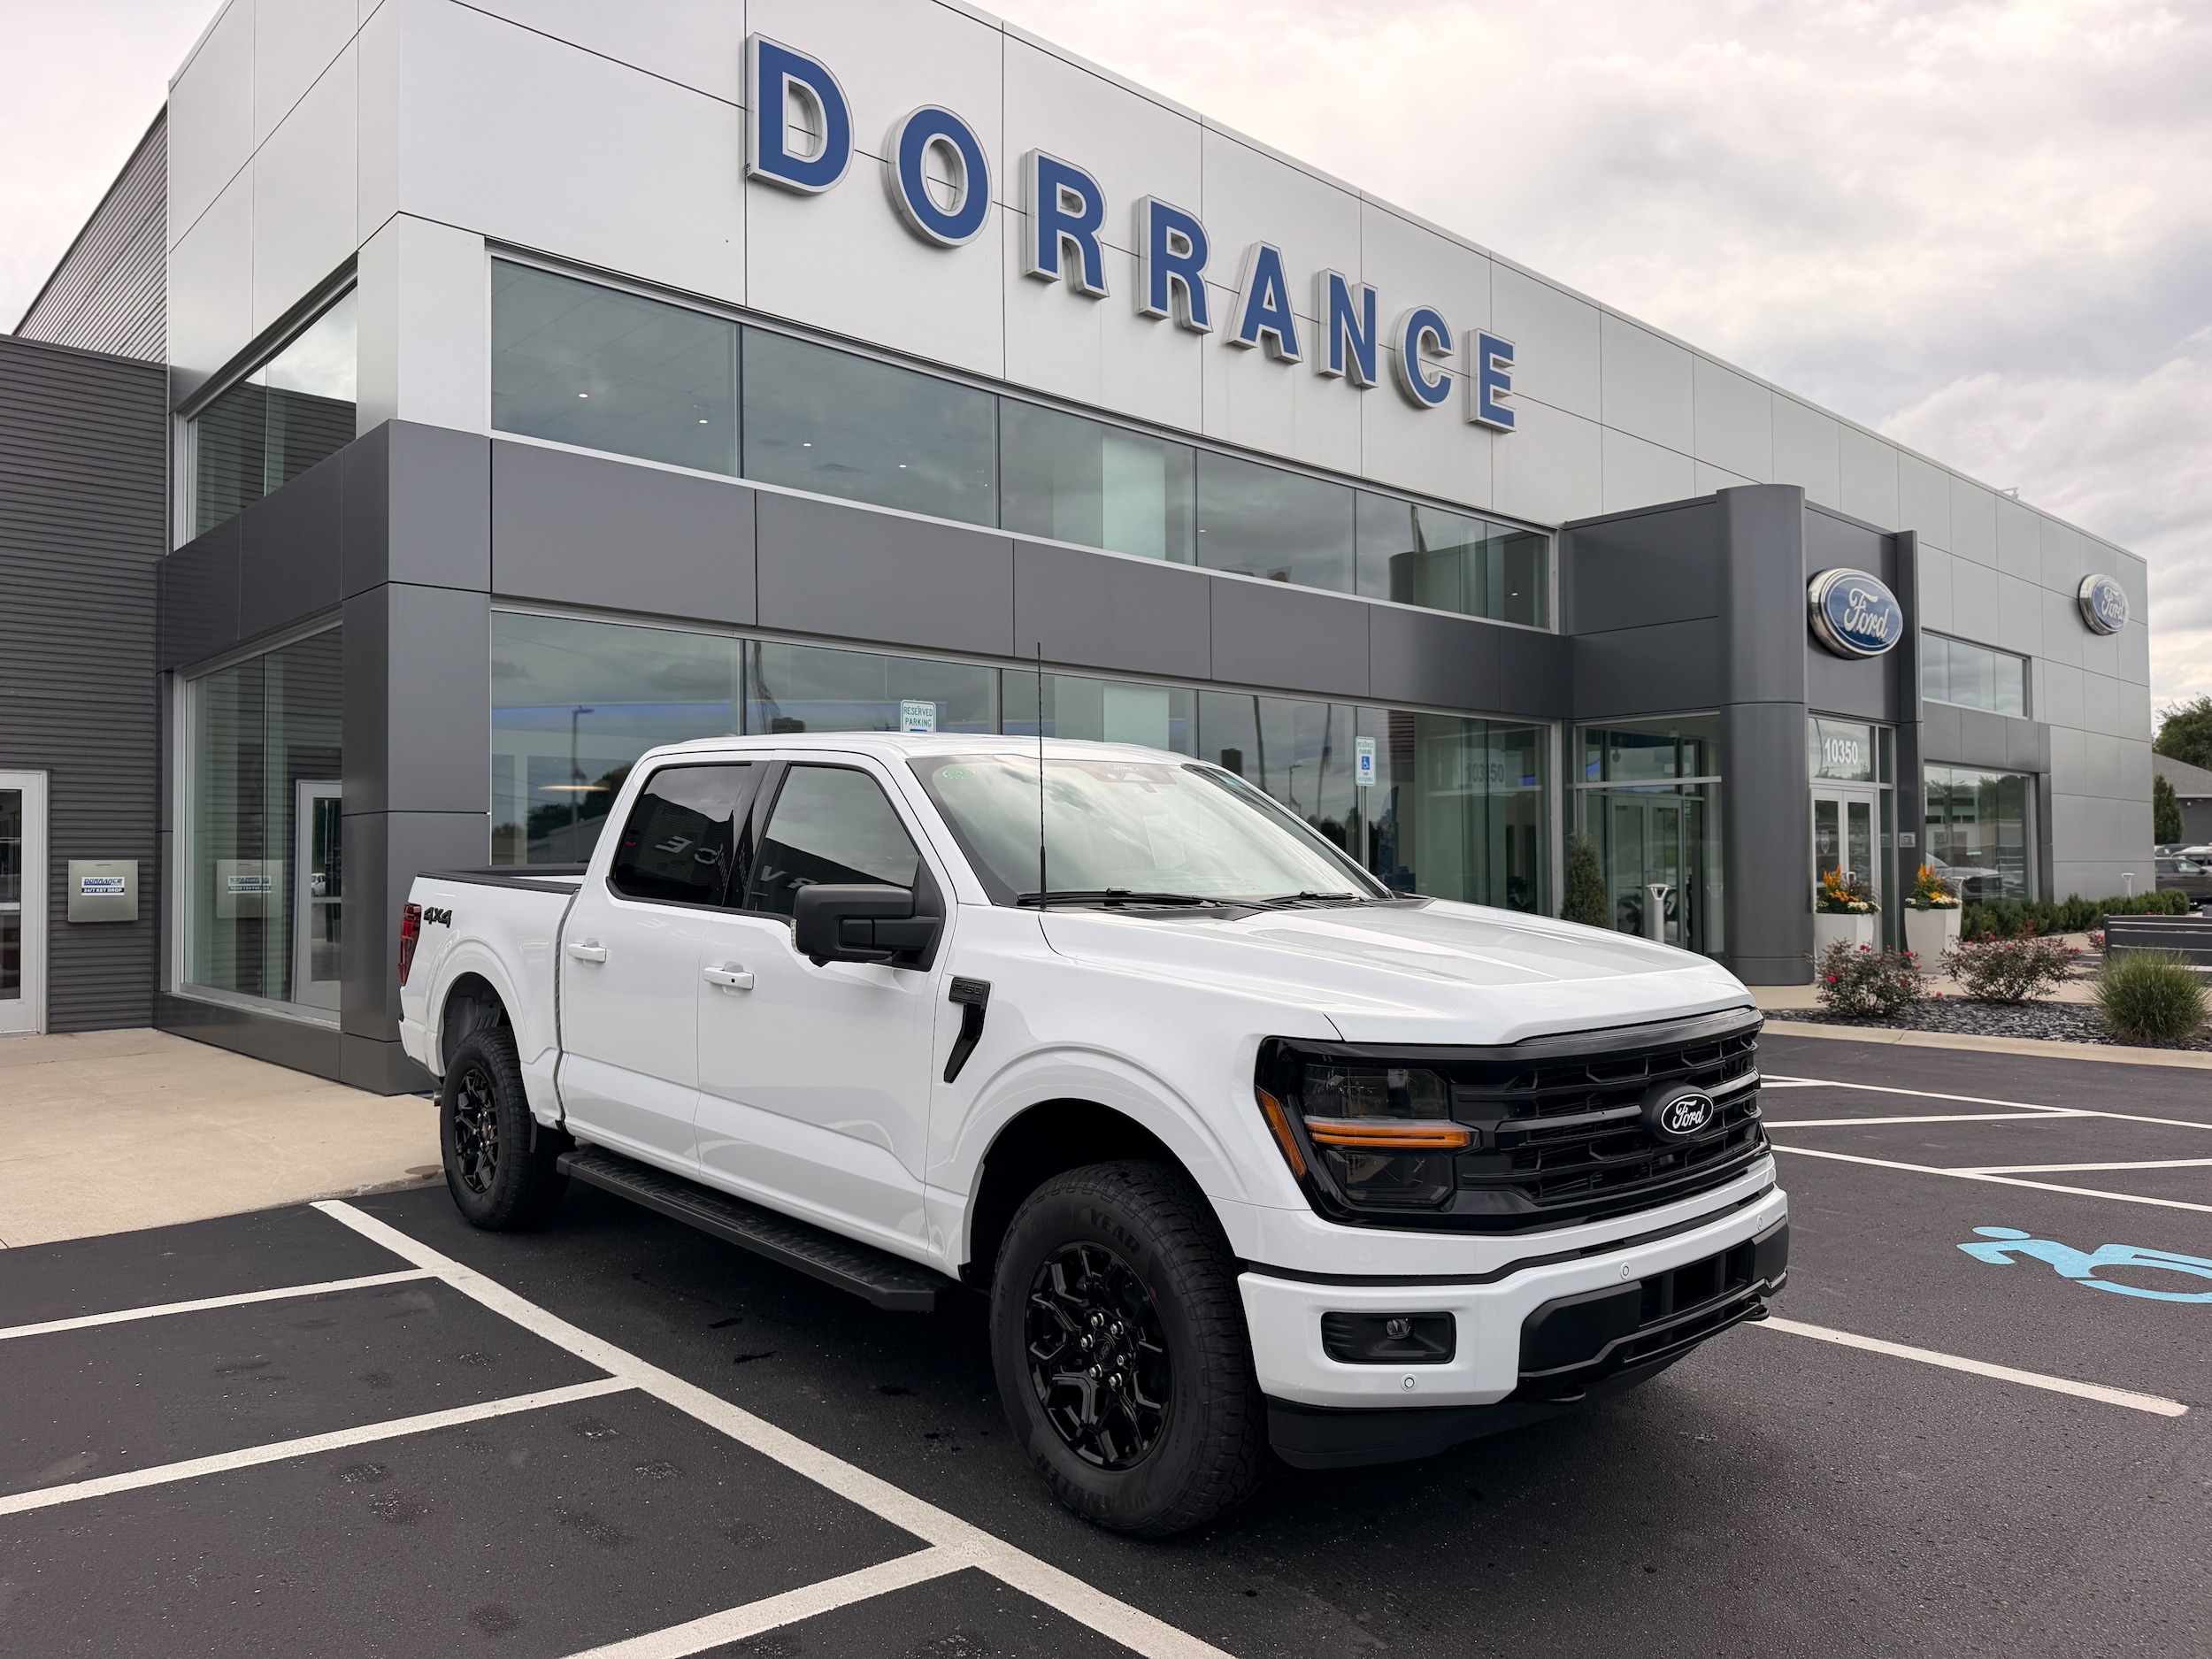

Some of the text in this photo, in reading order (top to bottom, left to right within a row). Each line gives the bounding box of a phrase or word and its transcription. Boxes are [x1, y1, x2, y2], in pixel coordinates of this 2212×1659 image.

[745, 31, 1517, 434] DORRANCE
[1844, 588, 1888, 639] Ford
[2102, 586, 2124, 621] Ford
[903, 706, 933, 717] RESERVED
[904, 717, 933, 727] PARKING
[1824, 738, 1858, 765] 10350
[1672, 1100, 1705, 1130] Ford
[1089, 1207, 1141, 1256] YEAR
